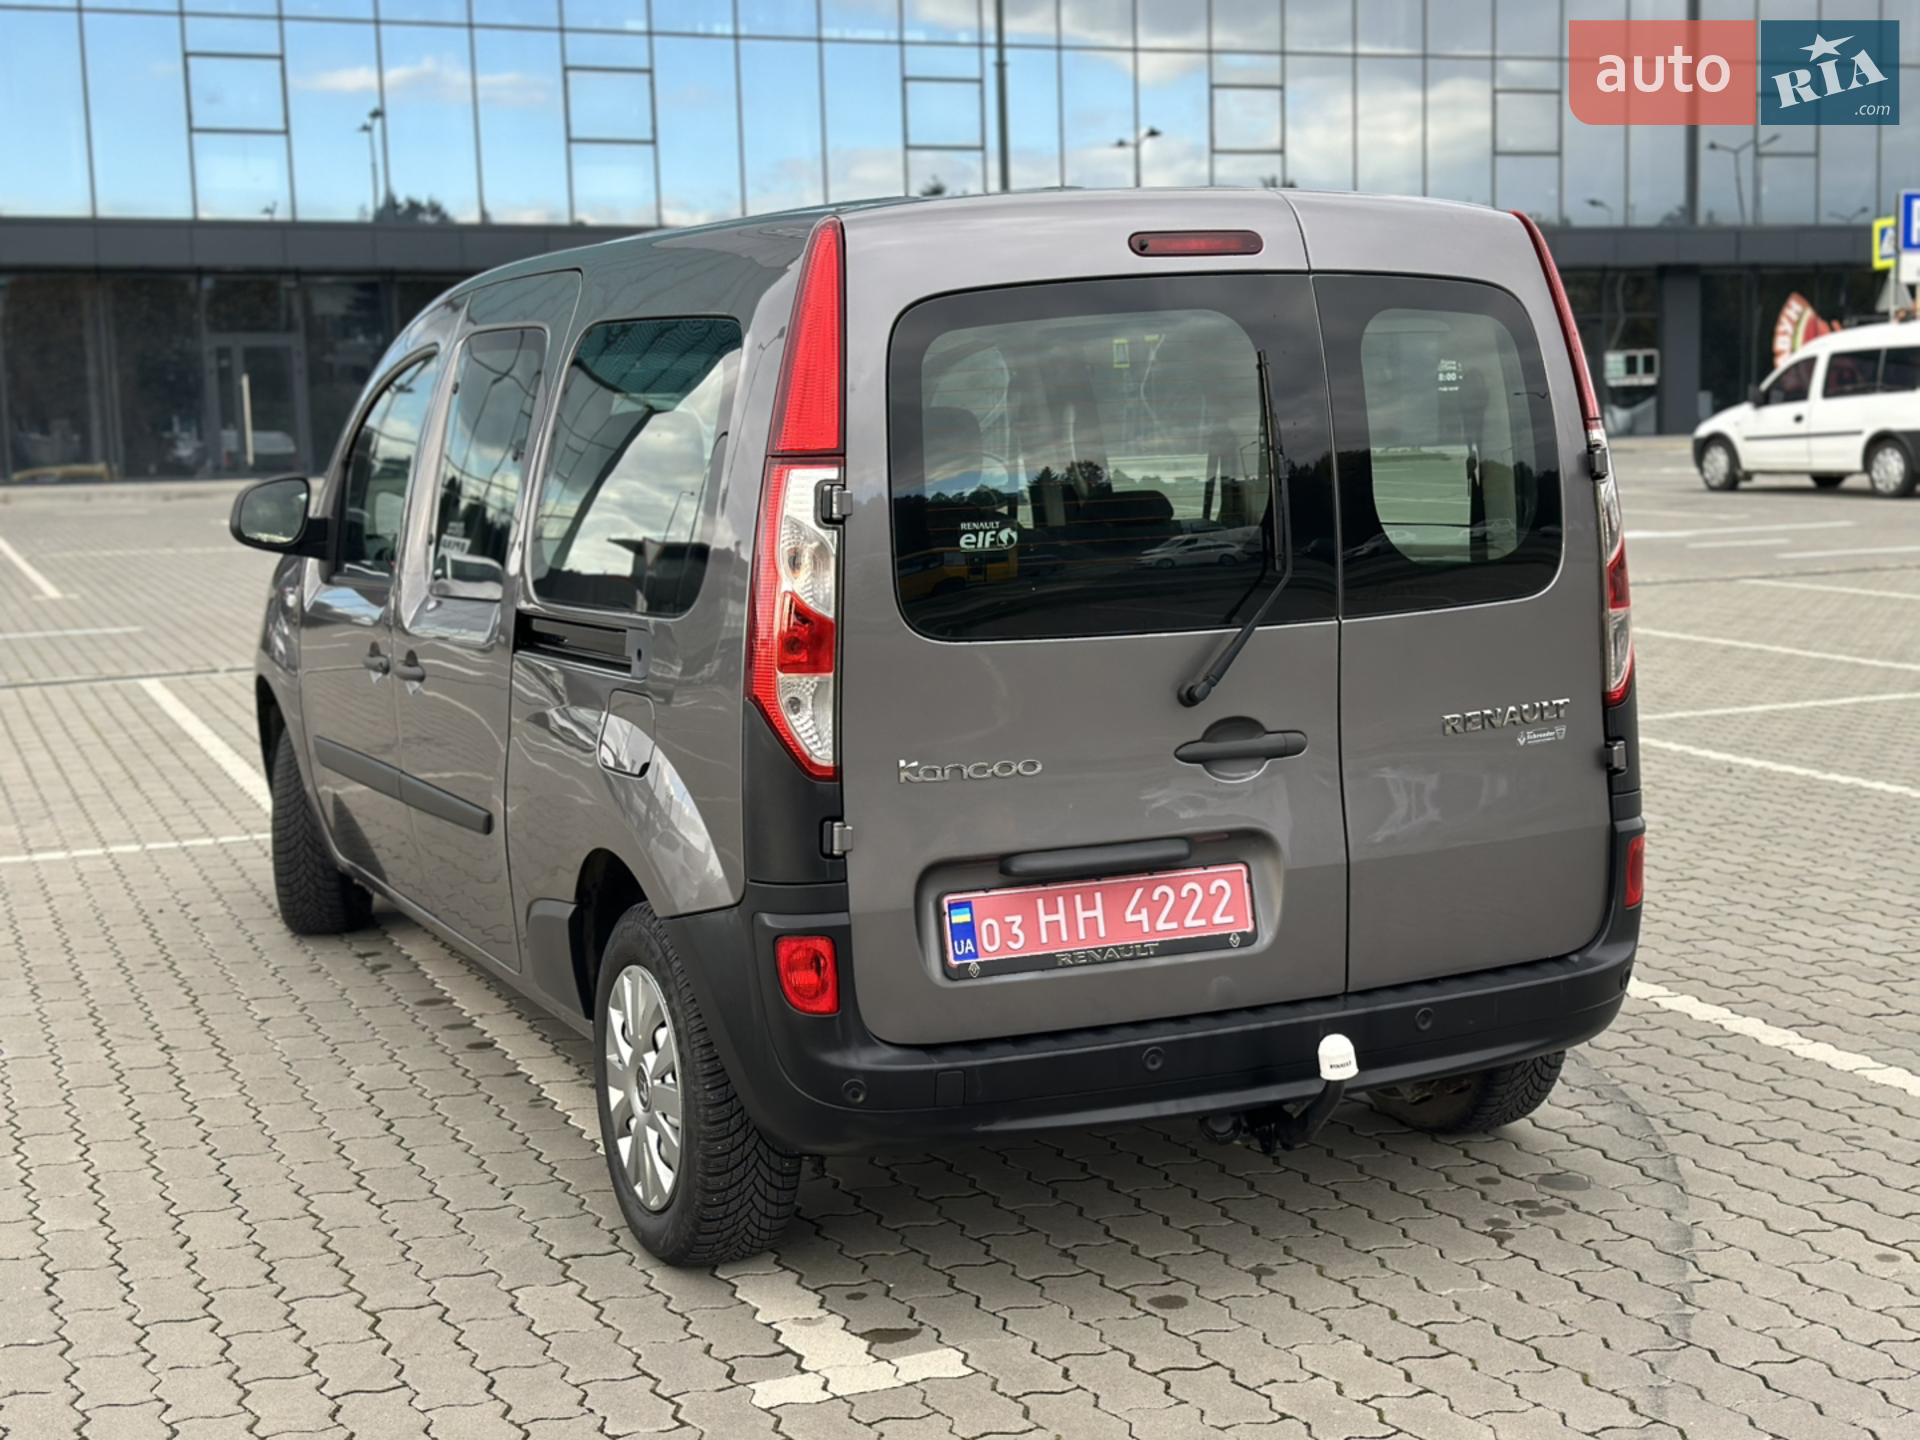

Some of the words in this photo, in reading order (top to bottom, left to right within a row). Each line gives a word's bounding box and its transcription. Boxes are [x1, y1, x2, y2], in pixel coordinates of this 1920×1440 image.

[960, 521, 1001, 531] RENAULT
[959, 531, 996, 549] elf
[1442, 698, 1570, 736] RENAULT
[899, 759, 1043, 783] Kangoo
[980, 914, 1026, 953] 03
[1036, 891, 1107, 945] HH
[1124, 878, 1235, 933] 4222
[953, 937, 976, 956] UA
[1055, 942, 1160, 966] RENAULT
